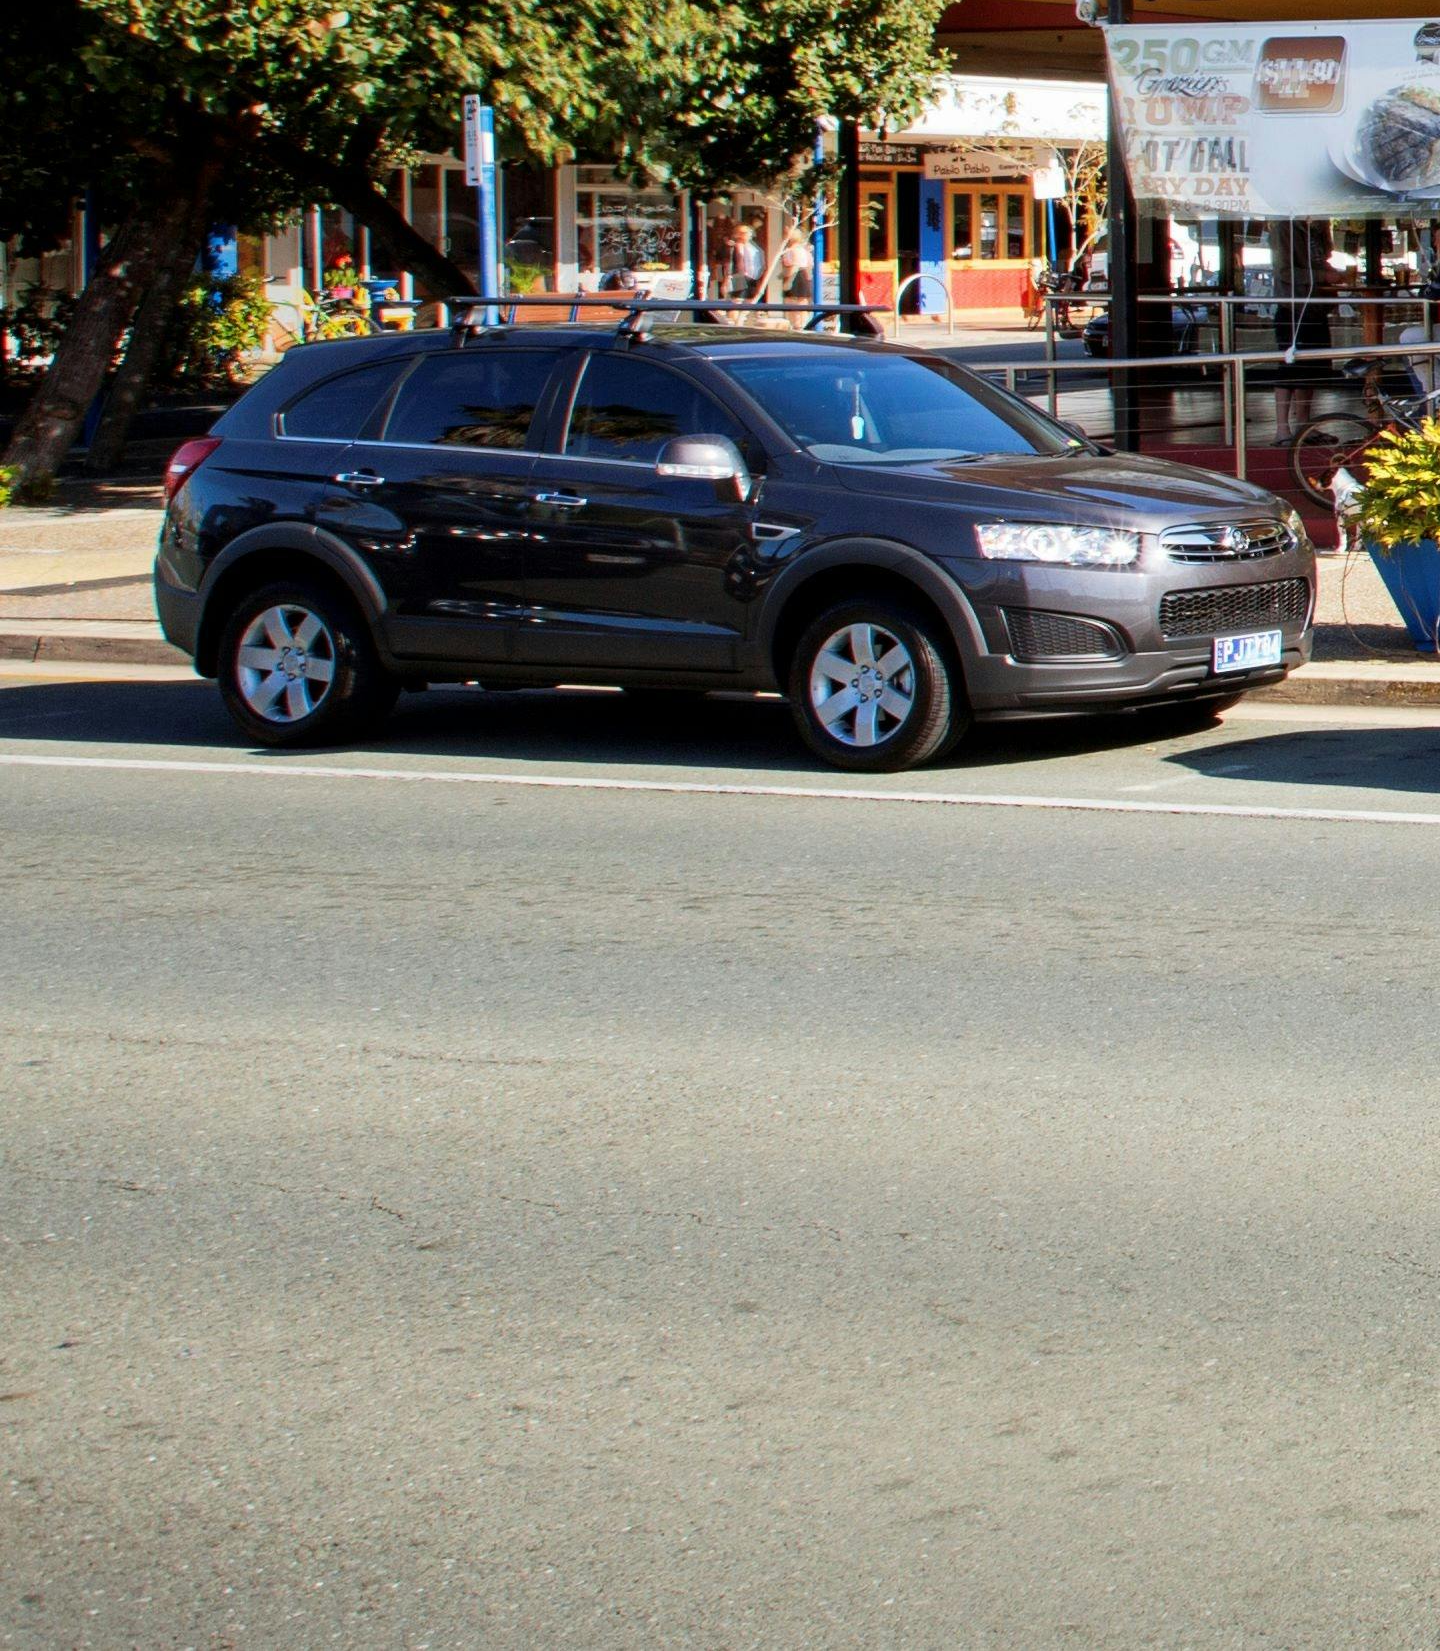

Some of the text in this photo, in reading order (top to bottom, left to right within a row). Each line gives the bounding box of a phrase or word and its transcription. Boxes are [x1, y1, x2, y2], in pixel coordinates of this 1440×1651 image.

[933, 165, 960, 176] Pablo
[963, 163, 990, 174] Pablo
[1193, 177, 1249, 196] DAY
